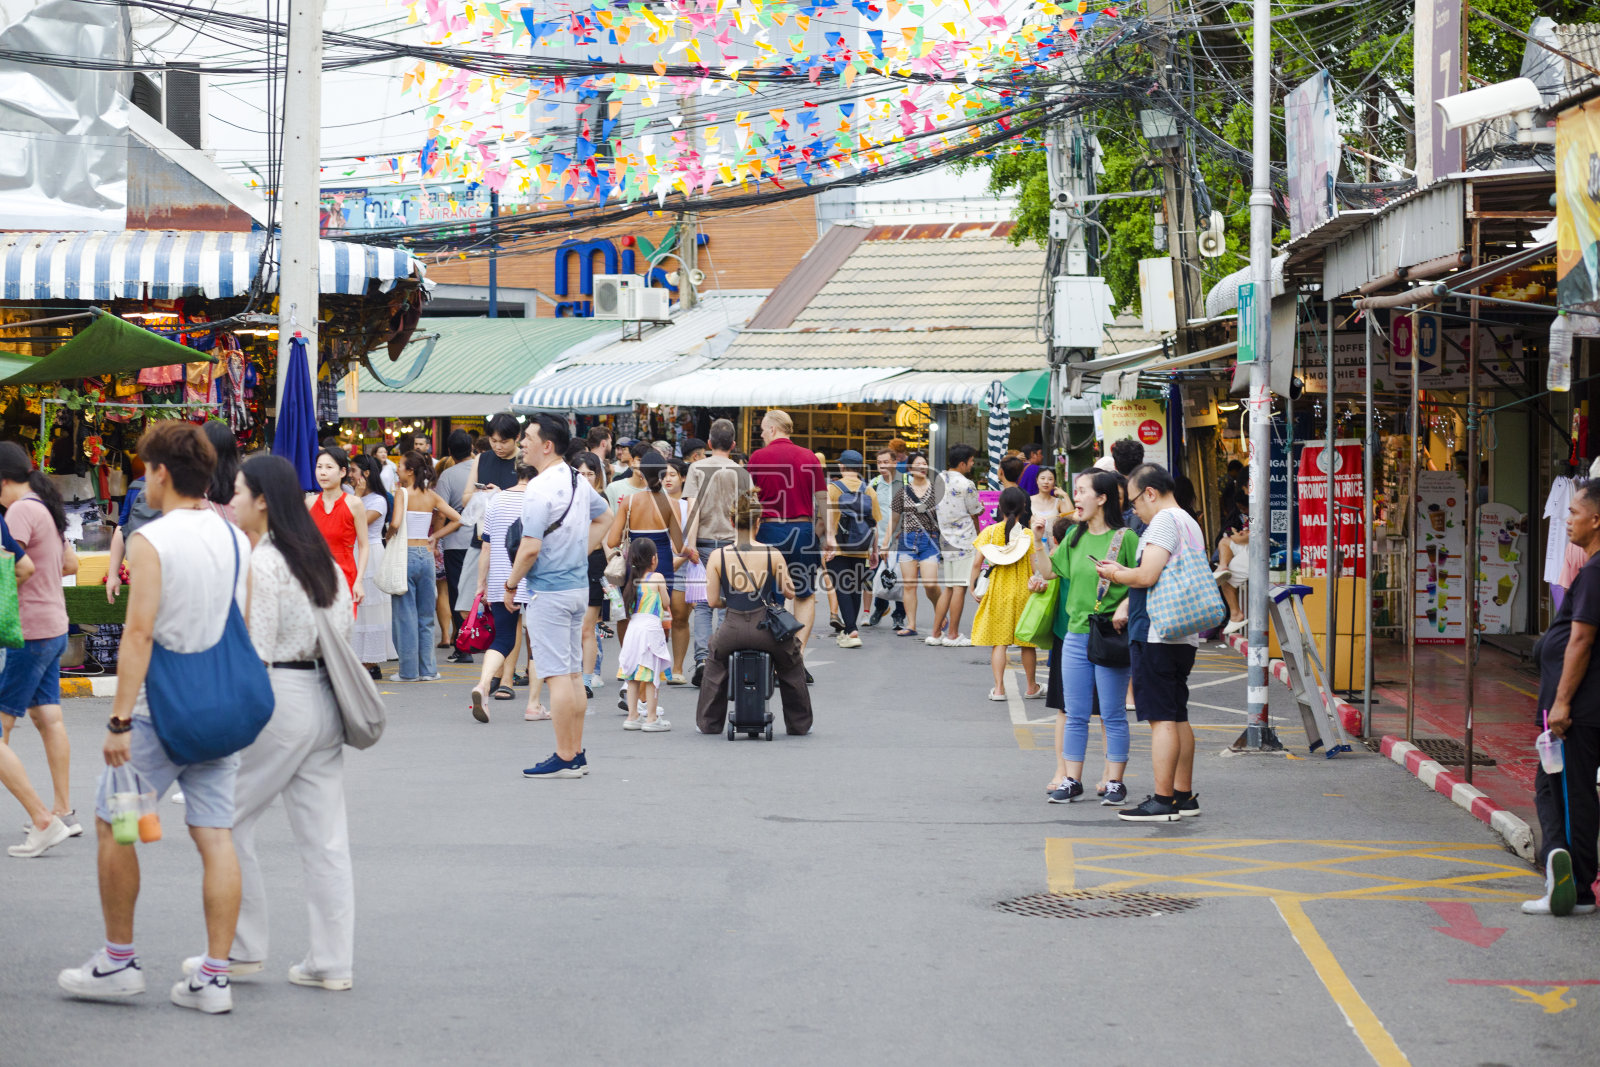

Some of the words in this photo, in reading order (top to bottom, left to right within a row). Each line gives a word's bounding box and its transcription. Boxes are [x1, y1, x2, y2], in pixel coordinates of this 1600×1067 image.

[419, 206, 483, 220] ENTRANCE
[1334, 344, 1367, 353] COFFE
[1338, 357, 1367, 366] LEMO
[1303, 370, 1355, 380] SMOHIE
[1299, 482, 1341, 499] PROMOTN
[1342, 481, 1364, 498] PRICE
[1302, 512, 1363, 527] MALYSIA
[1302, 543, 1365, 560] SINGORE
